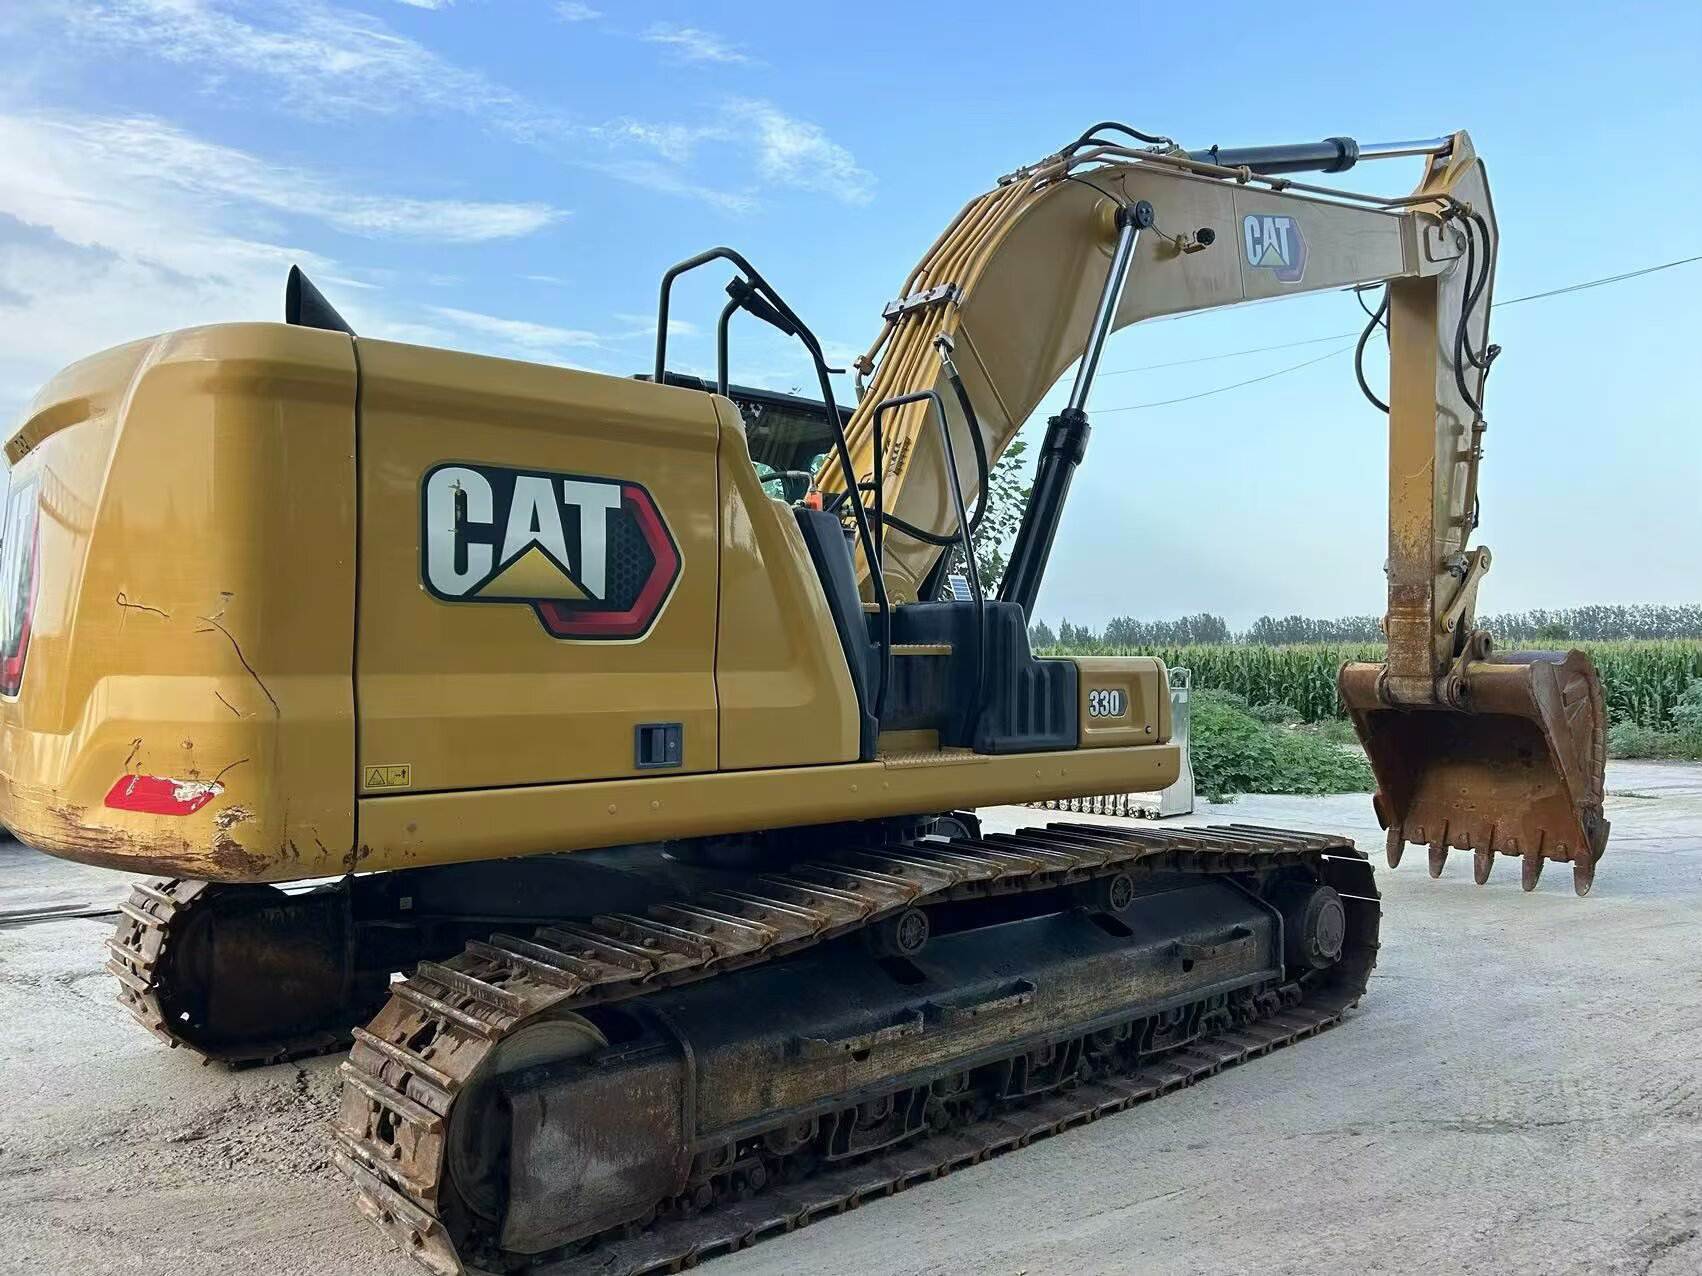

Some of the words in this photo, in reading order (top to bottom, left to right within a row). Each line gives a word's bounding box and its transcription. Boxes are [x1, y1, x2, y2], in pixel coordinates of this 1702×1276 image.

[1244, 215, 1290, 266] CAT
[427, 467, 622, 600] CAT
[1089, 690, 1120, 716] 330
